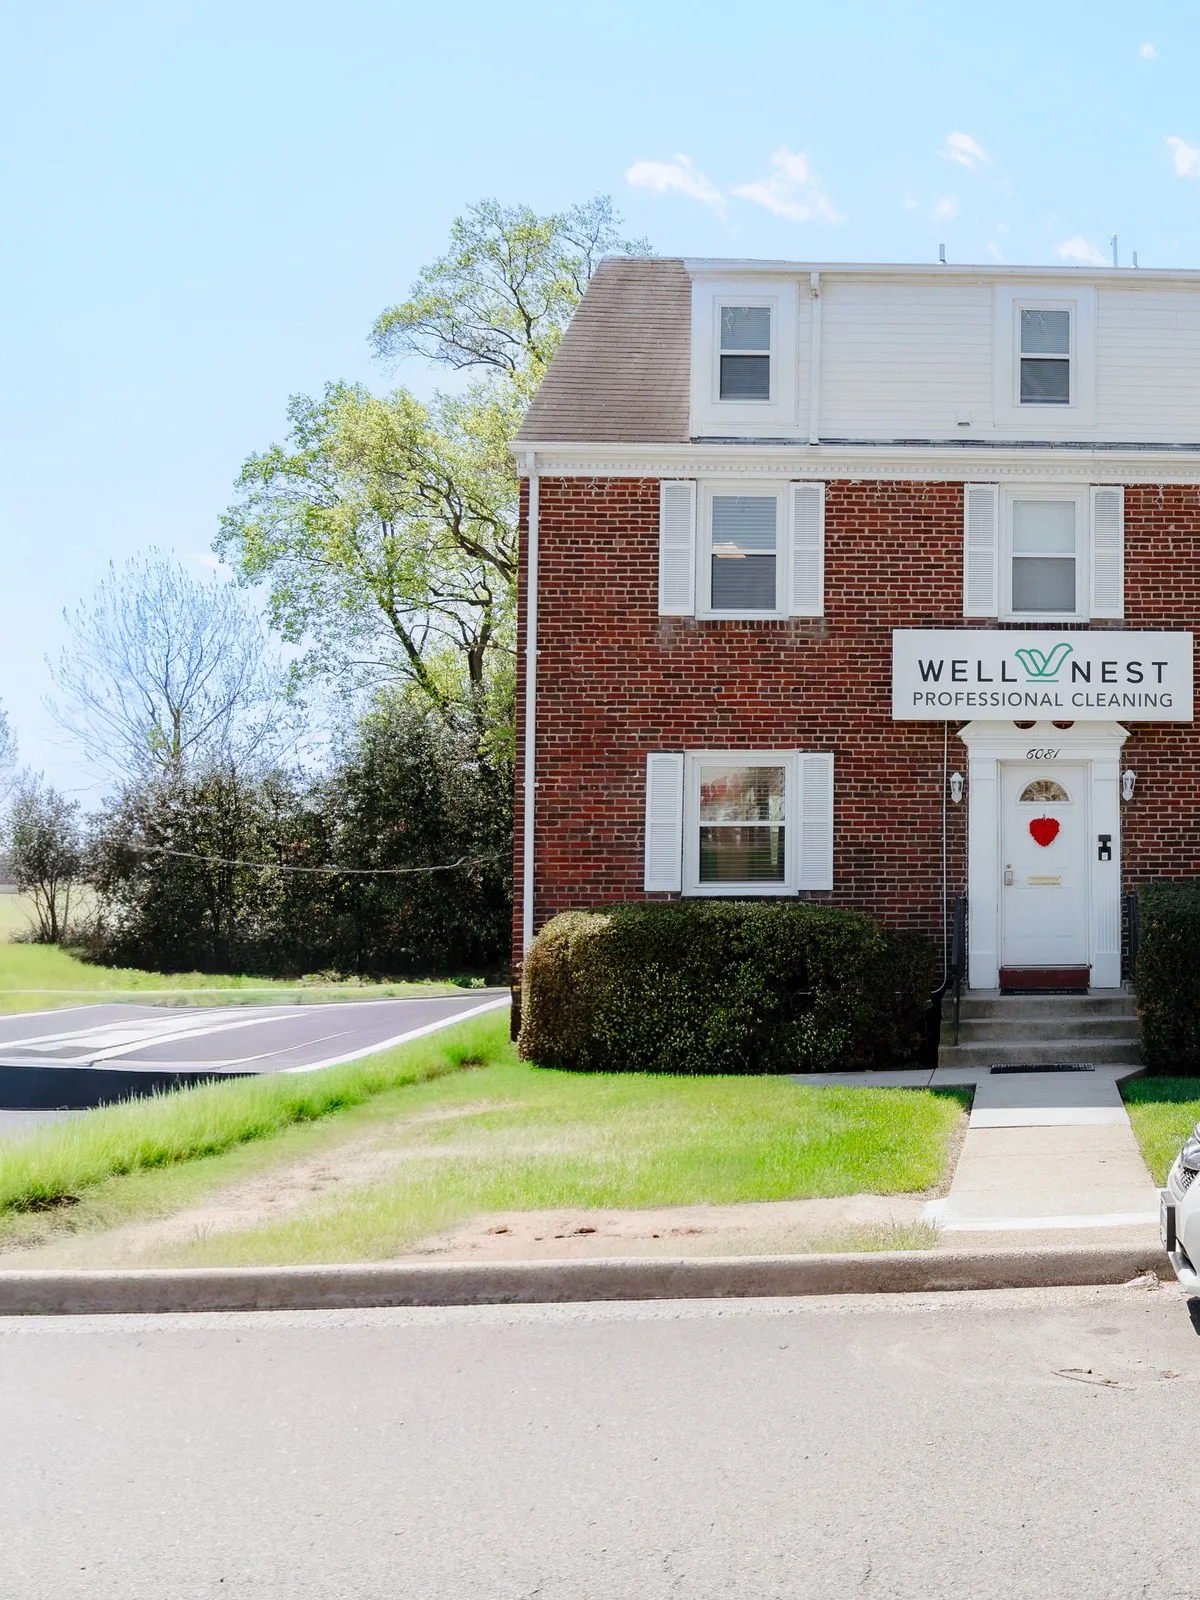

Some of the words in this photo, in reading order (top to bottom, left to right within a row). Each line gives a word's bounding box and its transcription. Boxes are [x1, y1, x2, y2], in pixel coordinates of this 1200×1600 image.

[918, 659, 1018, 683] WELL
[1072, 661, 1168, 684] NEST
[912, 691, 1064, 707] PROFESSIONAL
[1071, 692, 1173, 708] CLEANING
[1026, 748, 1061, 760] 6081
